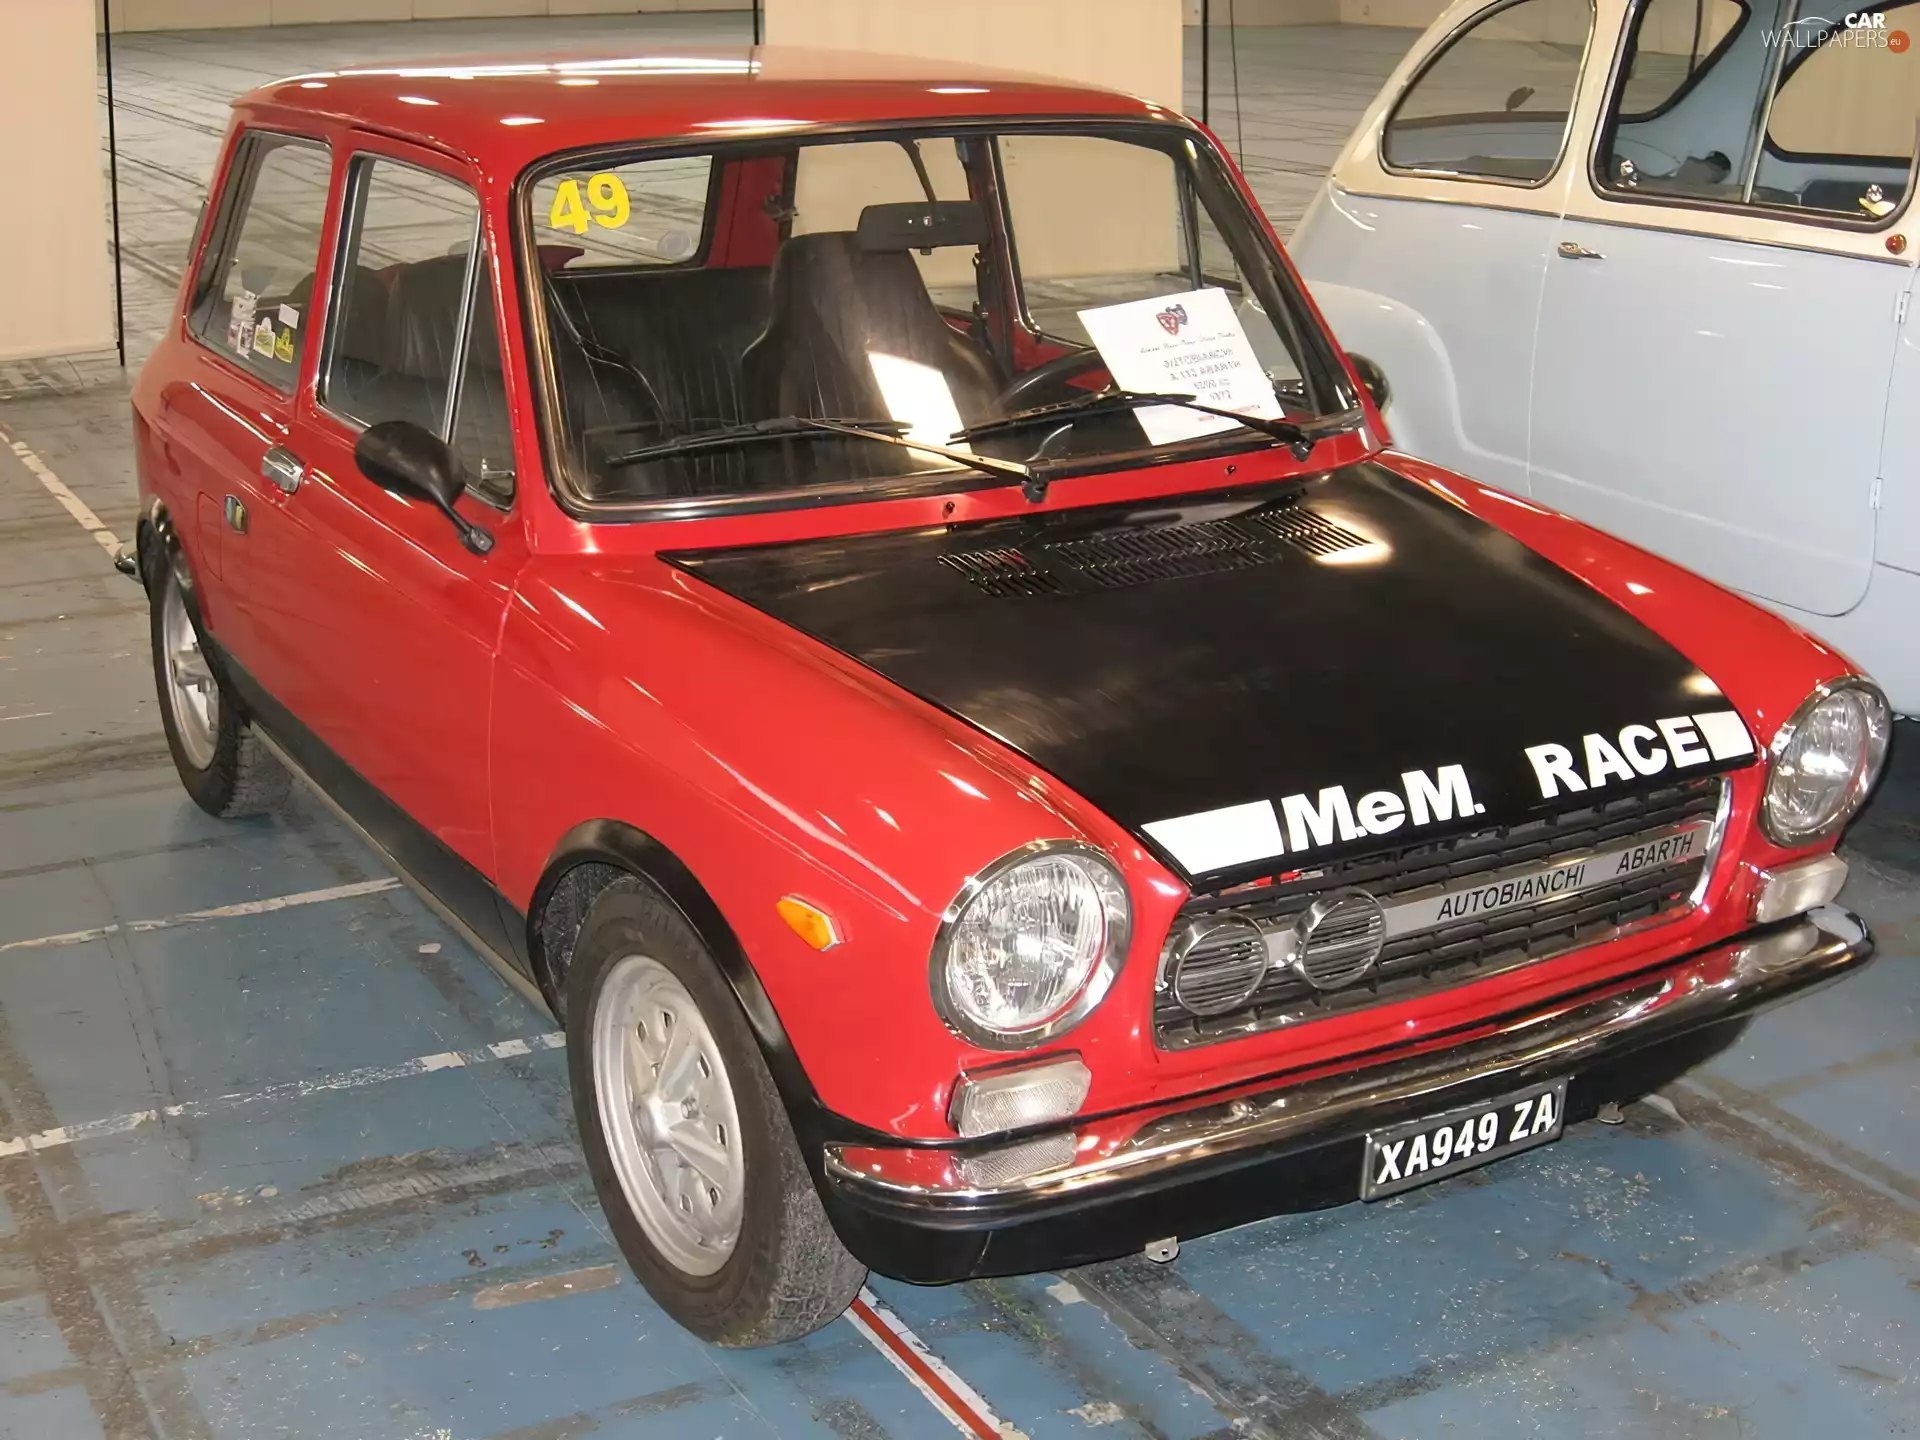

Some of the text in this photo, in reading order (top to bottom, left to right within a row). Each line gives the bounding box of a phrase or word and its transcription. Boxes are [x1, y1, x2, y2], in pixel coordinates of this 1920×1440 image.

[550, 173, 631, 235] 49
[1524, 716, 1710, 799] RACE
[1437, 832, 1695, 921] AUTOBIANCHI ABARTH
[1377, 1092, 1556, 1185] XA949 ZA
